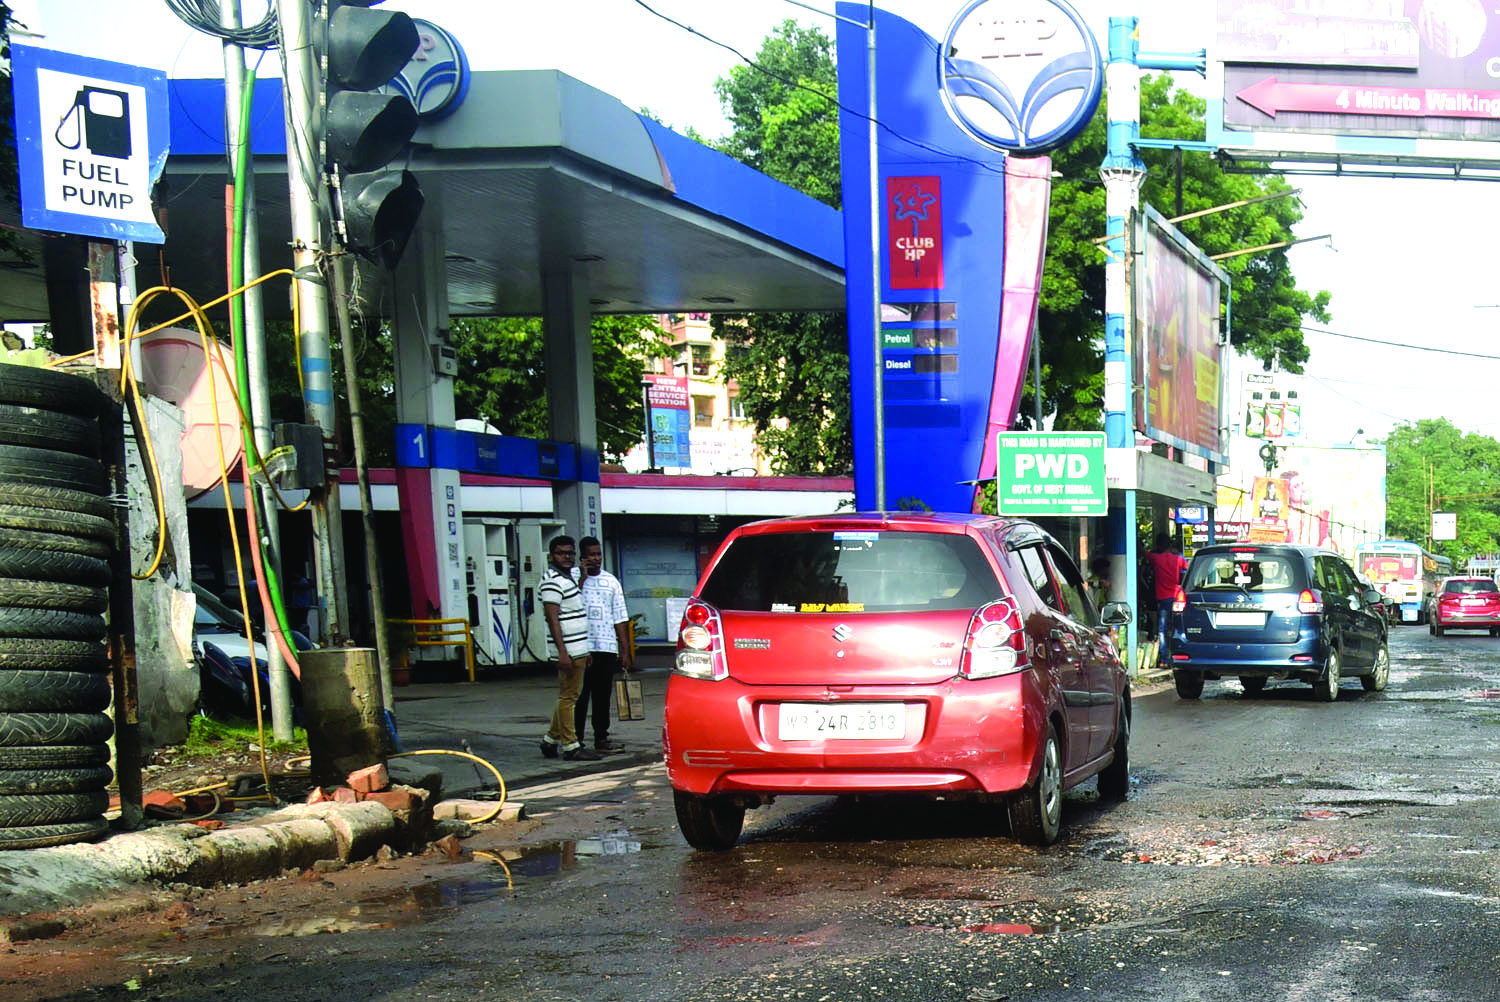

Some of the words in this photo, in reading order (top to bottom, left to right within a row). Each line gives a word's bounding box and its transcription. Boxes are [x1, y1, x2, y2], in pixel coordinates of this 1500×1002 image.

[1335, 90, 1350, 109] 4
[1355, 90, 1421, 111] Minute
[62, 158, 129, 186] FUEL
[62, 184, 134, 210] PUMP
[896, 237, 934, 249] CLUB
[905, 249, 926, 261] HP
[885, 334, 910, 344] Petrol
[886, 359, 911, 369] Diesel
[413, 433, 424, 458] 1
[1015, 453, 1090, 479] PWD
[817, 715, 848, 731] 24R
